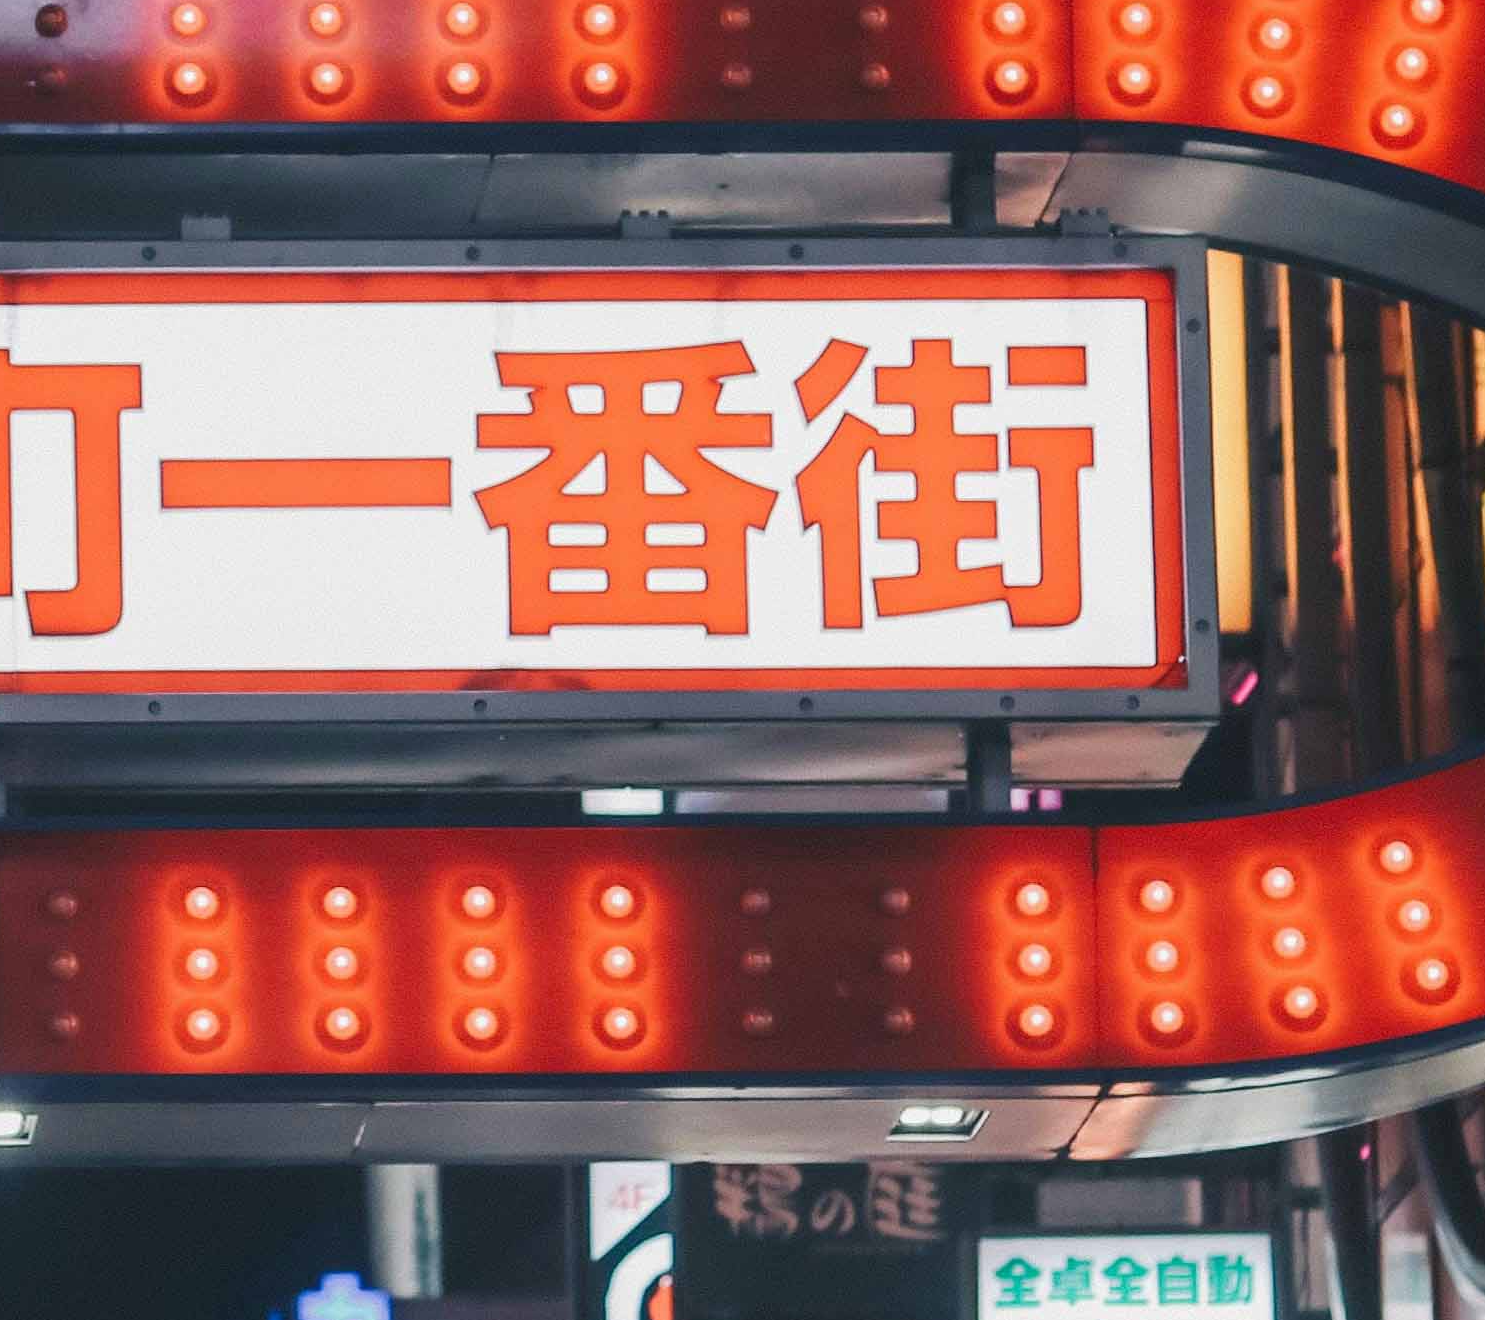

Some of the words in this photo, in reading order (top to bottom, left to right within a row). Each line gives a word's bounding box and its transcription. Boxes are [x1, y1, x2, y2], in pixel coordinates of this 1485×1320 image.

[994, 1255, 1256, 1307] 全卓全自動
